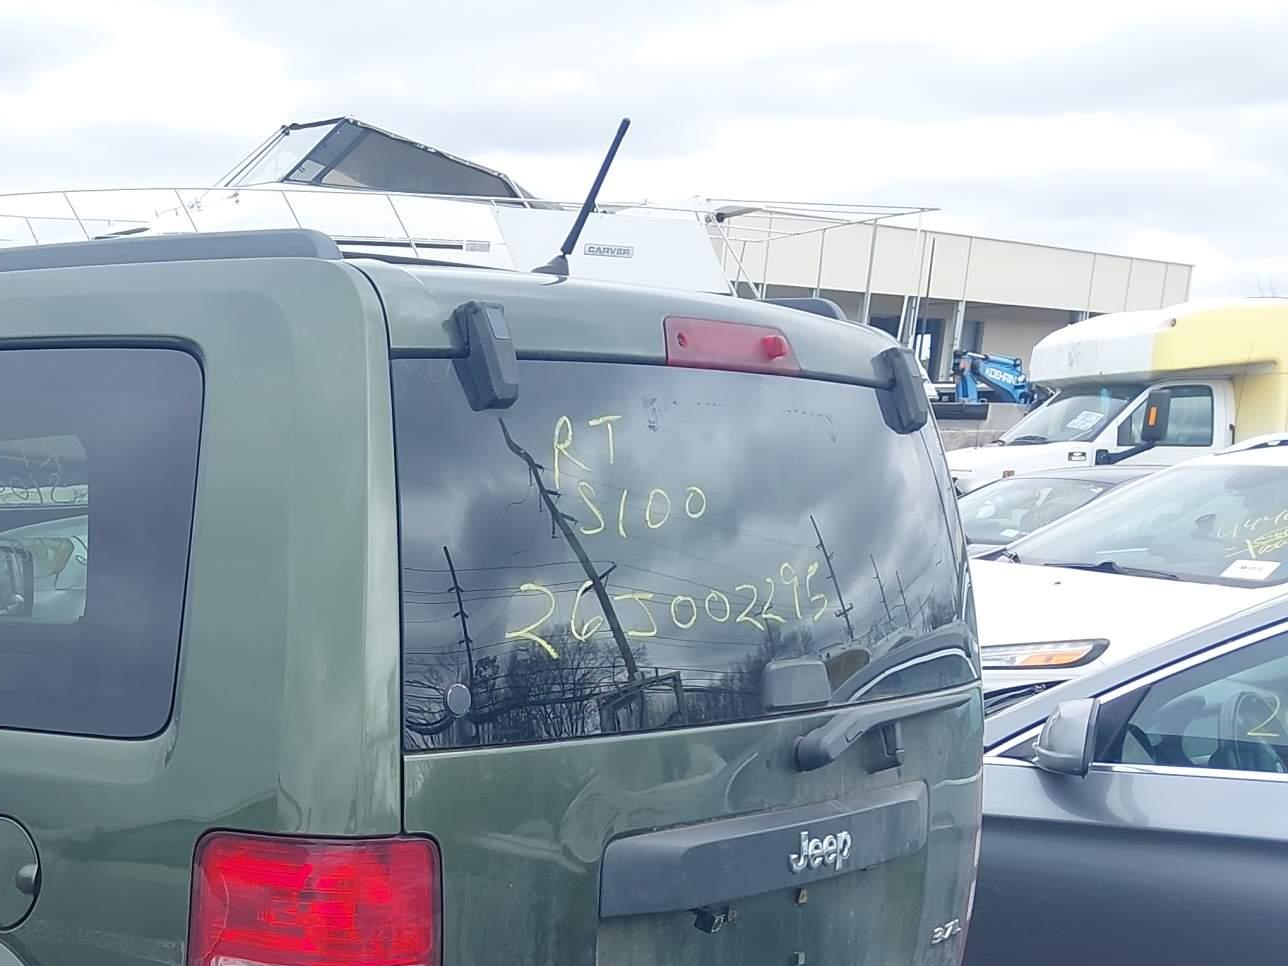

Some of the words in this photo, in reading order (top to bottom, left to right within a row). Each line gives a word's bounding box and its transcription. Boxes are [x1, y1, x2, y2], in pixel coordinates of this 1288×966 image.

[587, 246, 631, 257] CARVER
[577, 481, 707, 537] S100
[789, 831, 852, 871] Jeep
